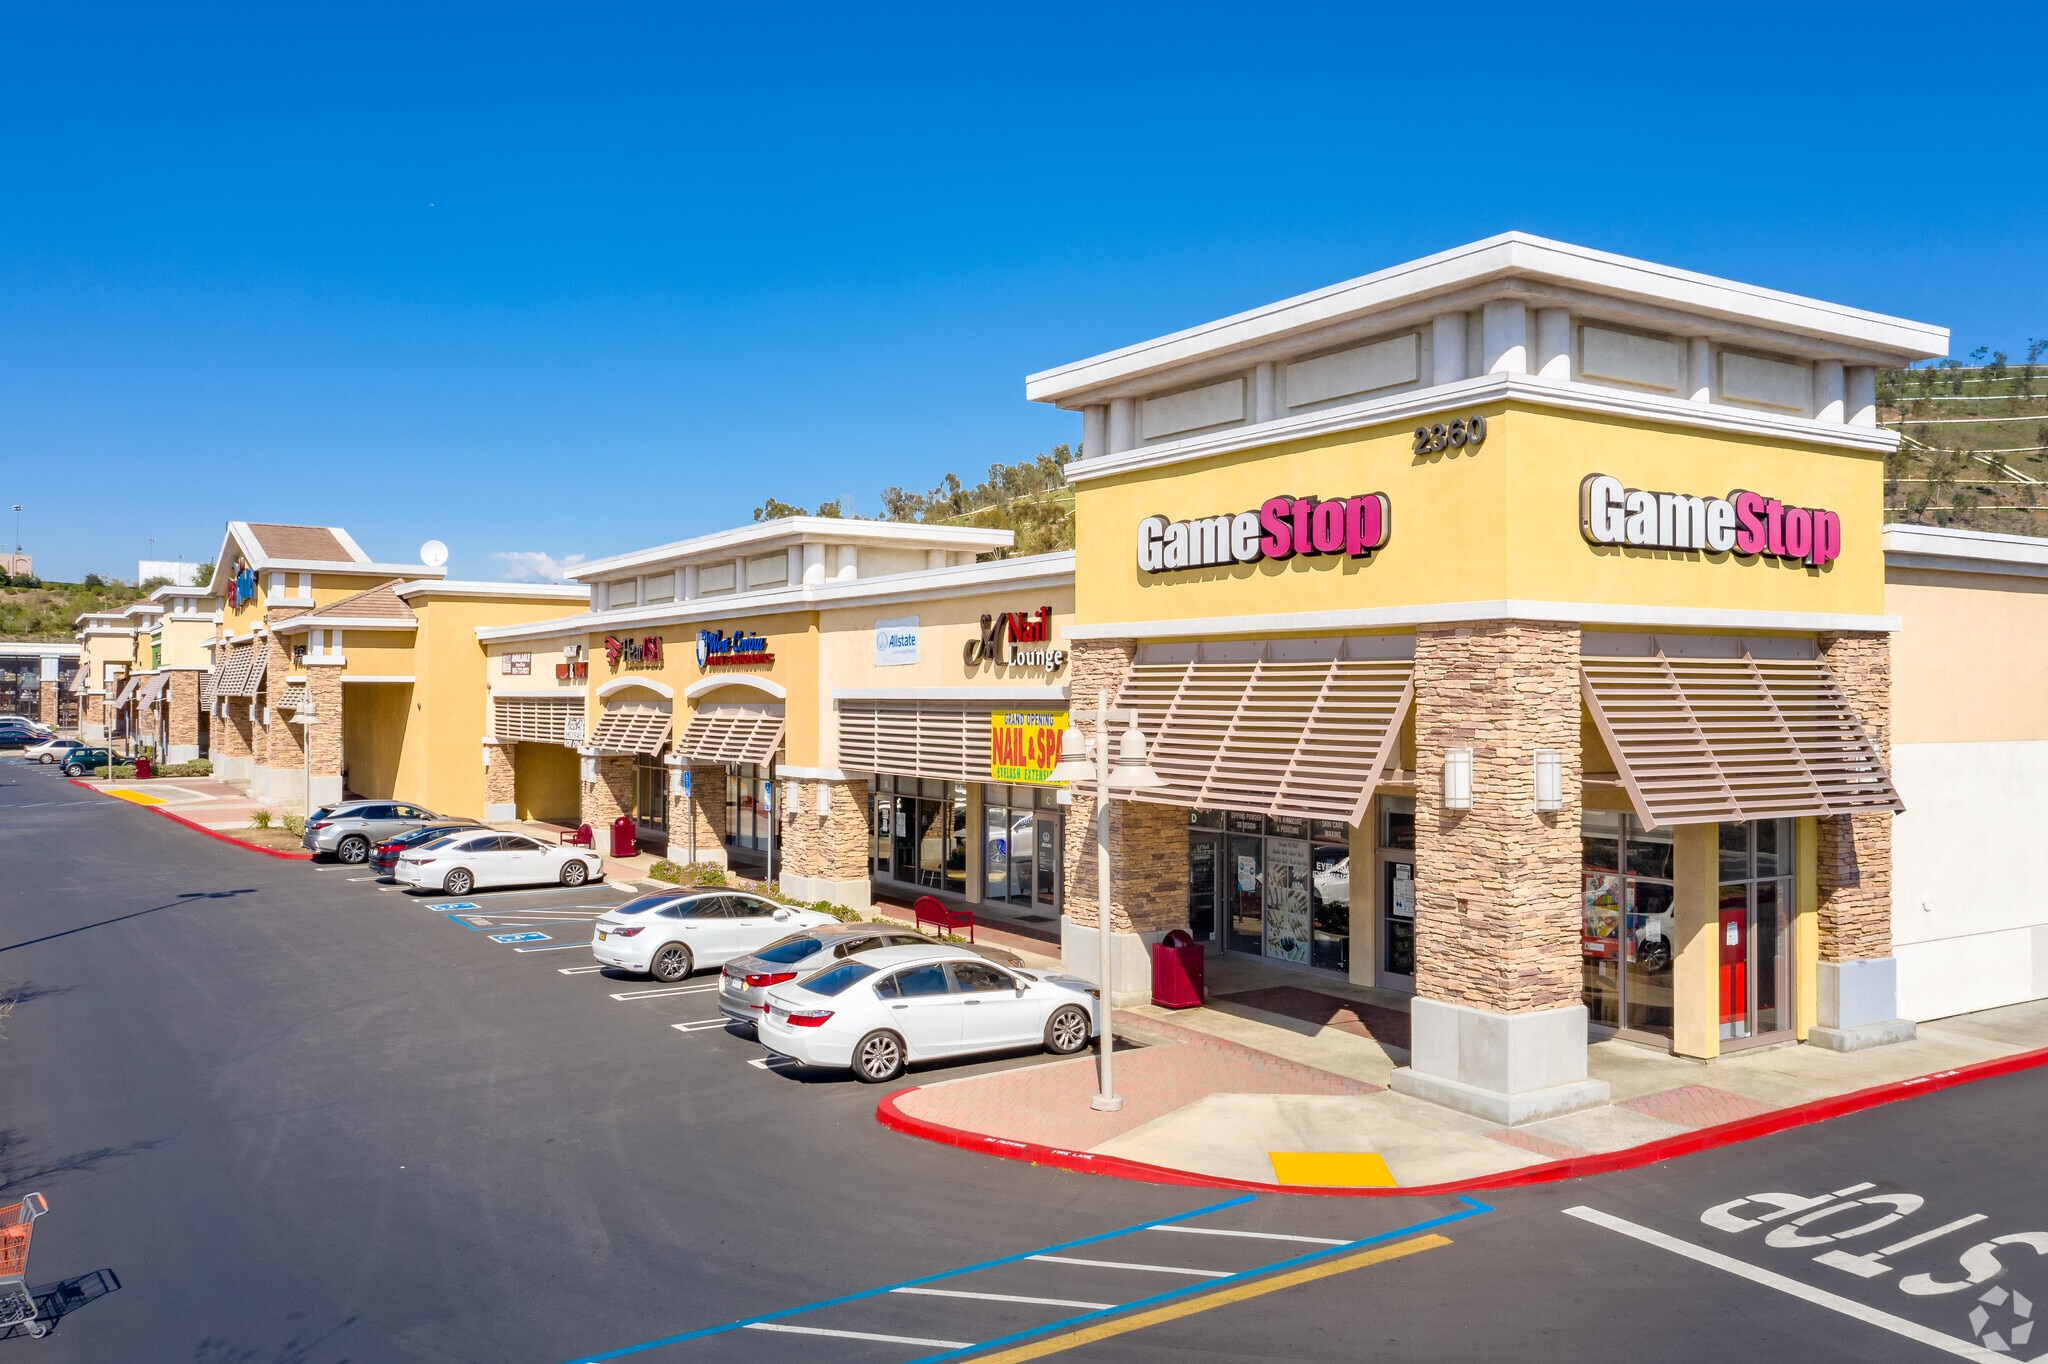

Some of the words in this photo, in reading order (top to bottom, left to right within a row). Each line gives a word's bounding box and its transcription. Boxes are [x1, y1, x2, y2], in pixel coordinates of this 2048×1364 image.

[1414, 415, 1487, 455] 2360
[1588, 475, 1841, 565] GameStop
[1137, 493, 1384, 571] GameStop
[1007, 606, 1048, 643] Nail
[707, 630, 730, 653] West
[731, 631, 767, 653] Covina
[888, 633, 916, 648] Allstate
[1008, 645, 1064, 672] Lounge
[1004, 713, 1024, 725] GRAND
[1026, 713, 1054, 726] OPENING
[993, 727, 1026, 767] NAIL
[1028, 736, 1035, 760] &
[1037, 728, 1064, 768] SPA
[997, 767, 1020, 779] EYELASH
[1024, 768, 1057, 782] EXTENSI
[1046, 796, 1051, 805] C
[1191, 814, 1197, 823] D
[1332, 821, 1344, 829] CARE
[996, 1139, 1028, 1149] PARKING
[1700, 1181, 2048, 1296] STOP
